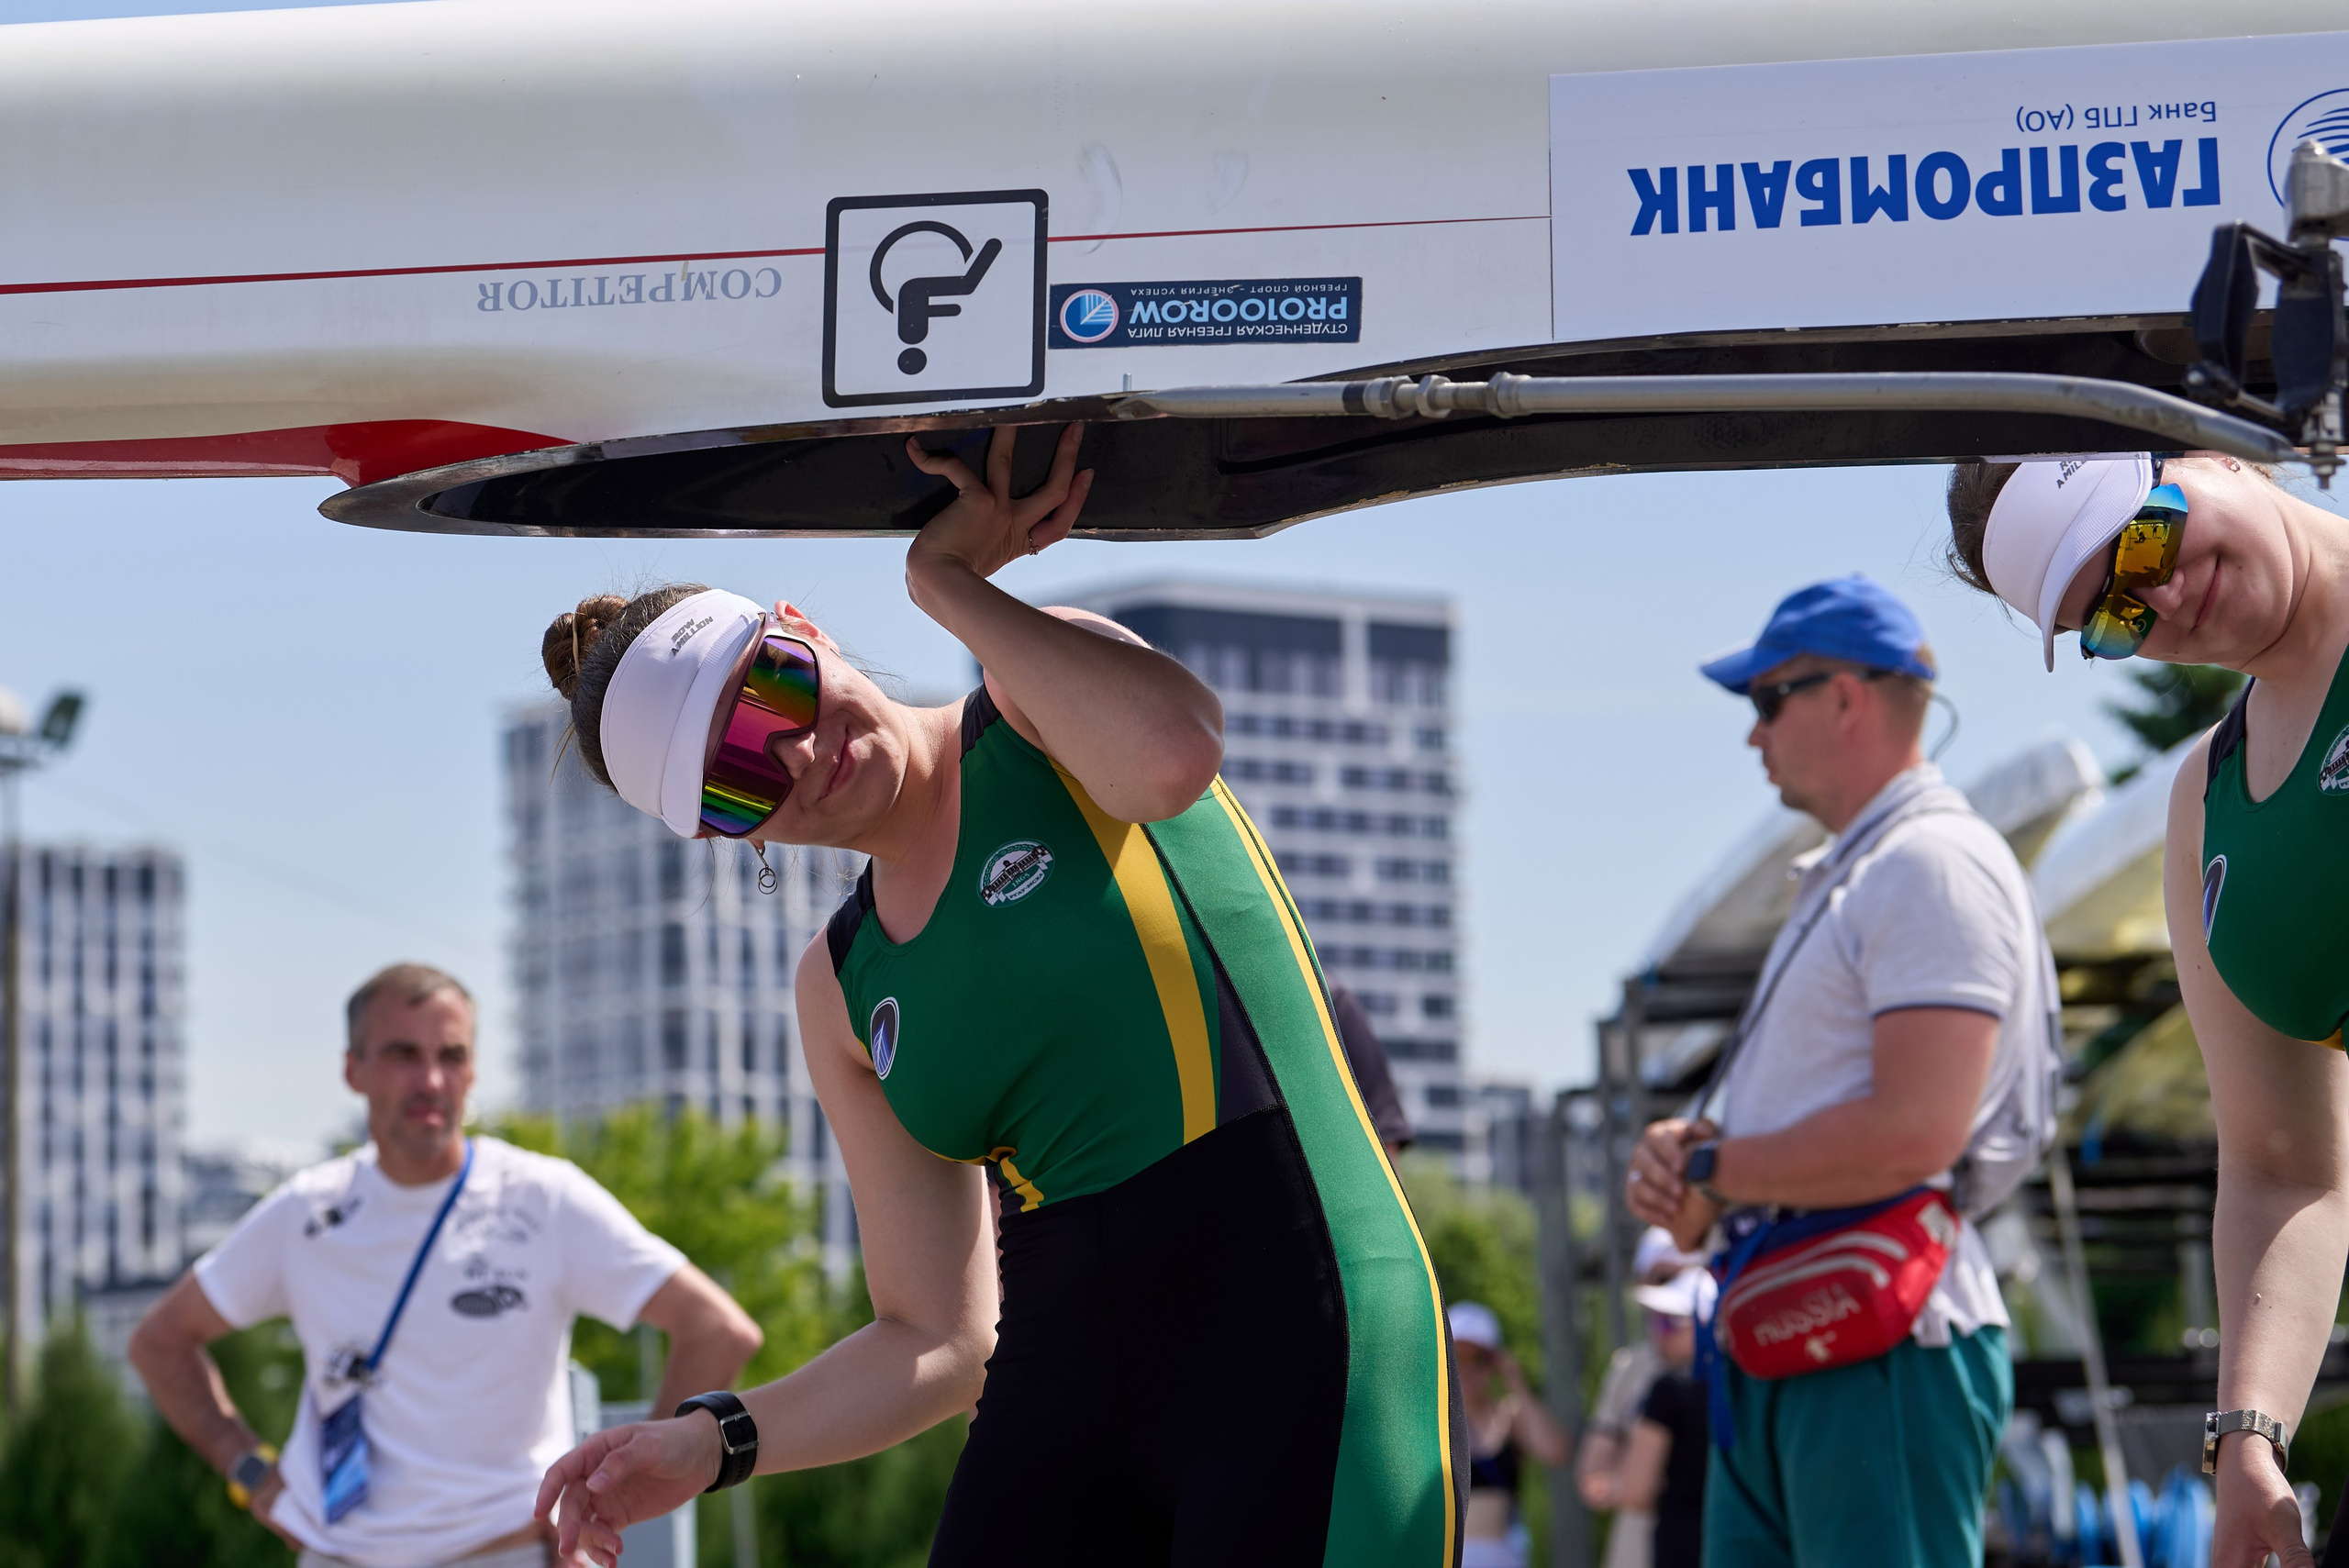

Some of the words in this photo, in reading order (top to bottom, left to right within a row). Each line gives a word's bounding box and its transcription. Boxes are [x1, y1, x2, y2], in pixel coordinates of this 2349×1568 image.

[2085, 106, 2139, 128] ГПБ
[2148, 101, 2217, 122] Банк
[2016, 108, 2075, 133] (АО)
[1627, 137, 2221, 236] ГАЗПРОМБАНК
[476, 267, 783, 313] COMPETITOR
[1130, 287, 1175, 295] УСПЕХА
[1180, 286, 1234, 295] ЭНЕРГИЯ
[1250, 284, 1289, 295] СПОРТ
[1294, 284, 1348, 293] ГРЕБНОЙ
[1127, 326, 1163, 339] ЛИГА
[1167, 325, 1232, 338] ГРЕБНАЯ
[1236, 323, 1348, 337] СТУДЕНЧЕСКАЯ
[676, 616, 714, 650] MILLION
[1012, 873, 1030, 887] 1865
